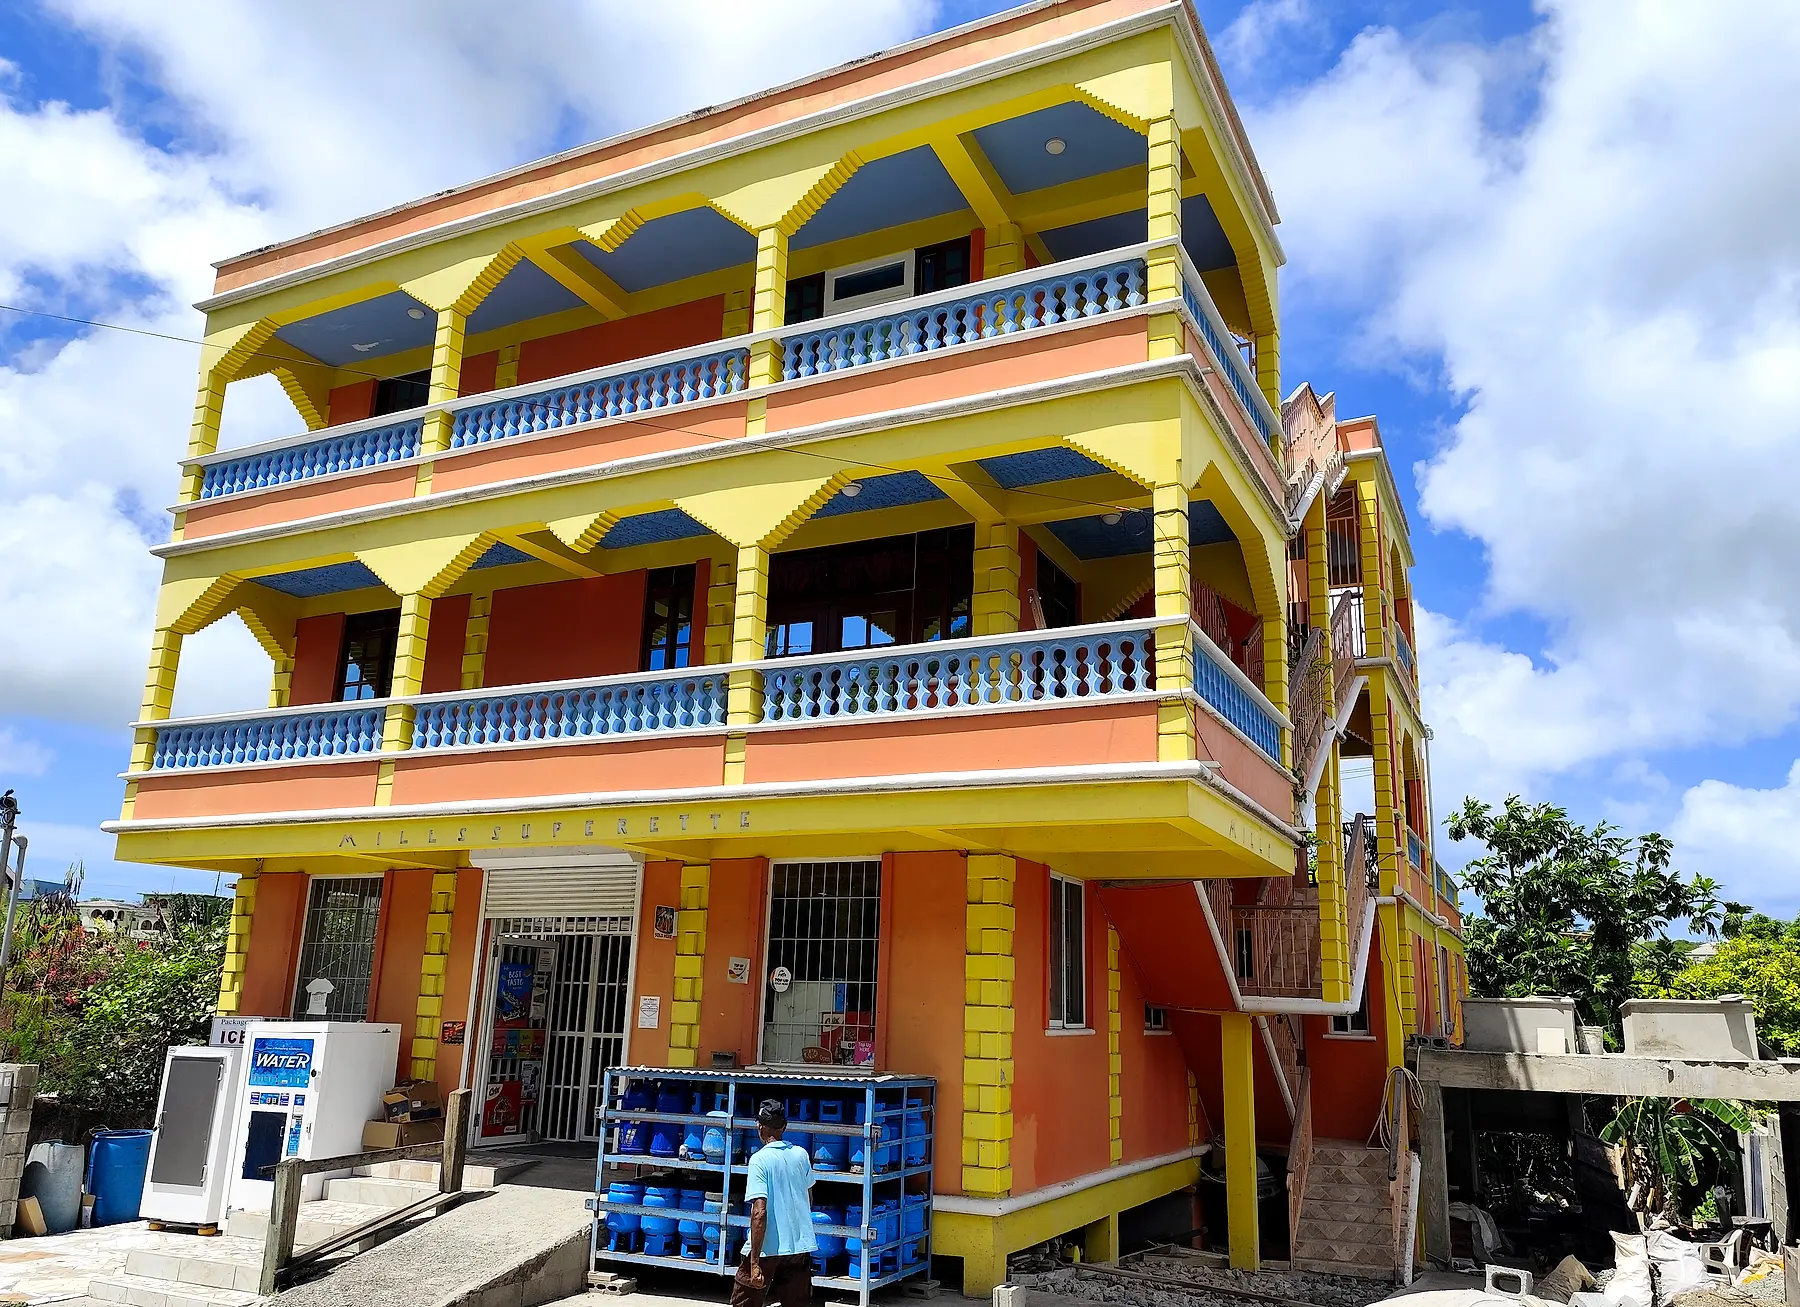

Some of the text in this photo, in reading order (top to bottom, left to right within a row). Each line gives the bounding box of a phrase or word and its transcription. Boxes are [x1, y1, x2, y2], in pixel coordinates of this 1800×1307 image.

[491, 811, 750, 841] SUPERETTE
[508, 970, 522, 978] BEST
[256, 1053, 310, 1068] WATER
